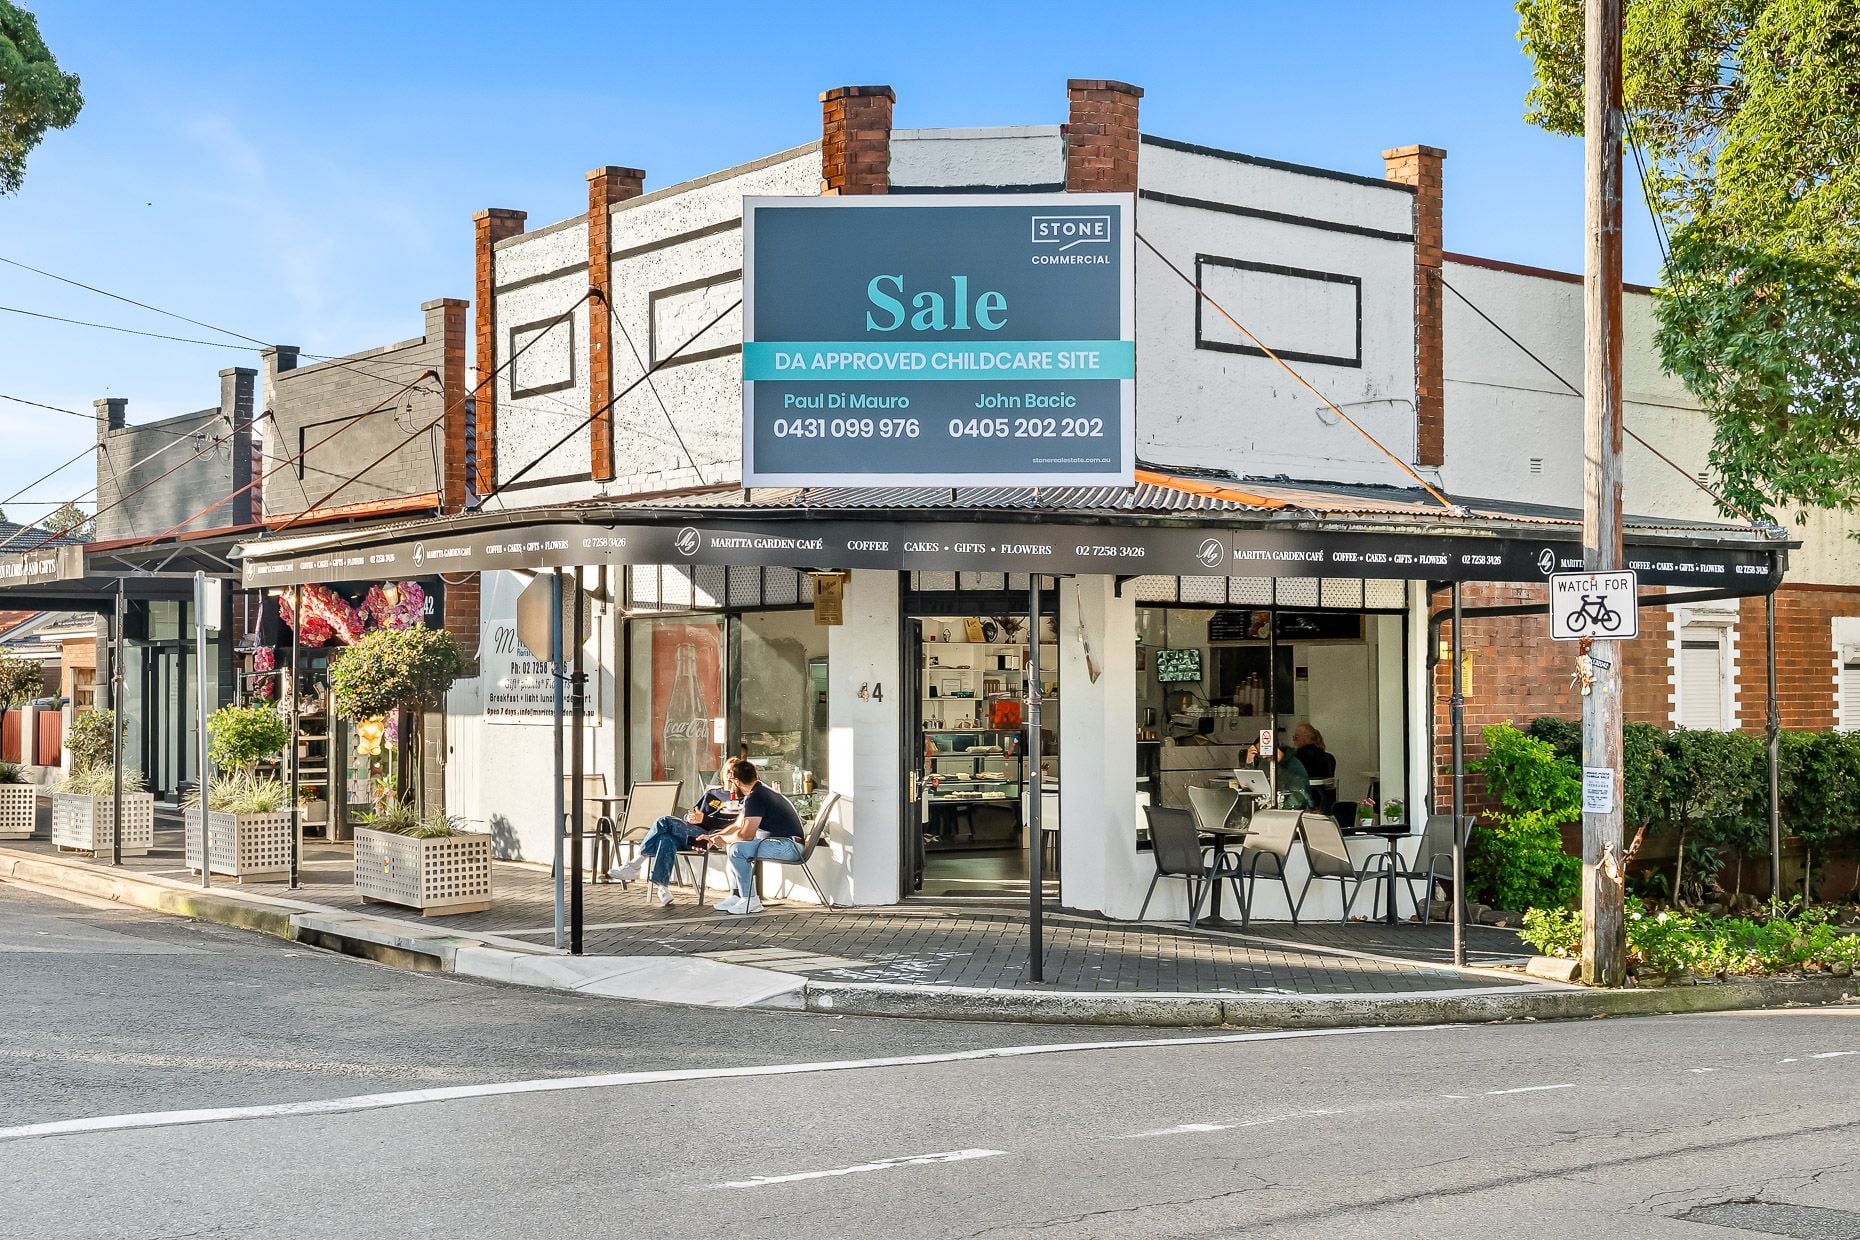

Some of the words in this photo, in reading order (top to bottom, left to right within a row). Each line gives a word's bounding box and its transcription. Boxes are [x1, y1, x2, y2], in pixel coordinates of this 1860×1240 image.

[1039, 222, 1104, 236] STONE
[1032, 255, 1110, 265] COMMERCIAL
[866, 274, 1008, 332] Sale
[775, 353, 806, 370] DA
[811, 352, 926, 370] APPROVED
[931, 352, 1052, 370] CHILDCARE
[1058, 351, 1100, 369] SITE
[784, 394, 824, 408] Paul
[828, 394, 846, 408] Di
[850, 394, 910, 408] Mauro
[975, 393, 1020, 408] John
[1026, 392, 1077, 408] Bacic
[773, 419, 826, 438] 0431
[830, 419, 875, 438] 099
[879, 418, 920, 438] 976
[949, 418, 1010, 438] 0405
[1014, 418, 1056, 438] 202
[1061, 418, 1104, 438] 202
[526, 542, 540, 552] GIFTS
[545, 540, 568, 550] FLOWERS
[582, 538, 591, 548] 02
[592, 538, 608, 548] 7258
[711, 538, 753, 548] MARITTA
[754, 538, 795, 549] GARDEN
[796, 538, 823, 550] CAFÉ
[847, 540, 888, 551] COFFEE
[904, 542, 939, 552] CAKES
[954, 543, 986, 553] GIFTS
[1001, 544, 1052, 554] FLOWERS
[1076, 546, 1090, 556] 02
[1092, 546, 1117, 556] 7258
[1119, 546, 1144, 556] 3426
[1234, 550, 1272, 560] MARITTA
[1272, 551, 1305, 561] GARDEN
[1305, 550, 1324, 562] CAFÉ
[1332, 552, 1358, 562] COFFEE
[1366, 553, 1386, 562] CAKES
[1394, 554, 1412, 564] GIFTS
[1420, 555, 1448, 564] FLOWERS
[1462, 555, 1470, 564] 02
[1472, 555, 1486, 564] 7258
[1486, 555, 1502, 565] 3426
[1629, 561, 1650, 570] COFFEE
[1656, 562, 1674, 571] CAKES
[1680, 564, 1694, 572] GIFTS
[1700, 564, 1724, 573] FLOWERS
[1736, 565, 1742, 574] 02
[1558, 580, 1598, 592] WATCH
[1604, 578, 1628, 590] FOR
[424, 596, 434, 614] 42
[511, 662, 520, 674] Ph:
[522, 662, 530, 674] 02
[533, 662, 548, 674] 7258
[490, 693, 518, 702] Breakfast
[858, 682, 884, 702] 44
[487, 708, 500, 716] Open
[505, 708, 516, 716] days
